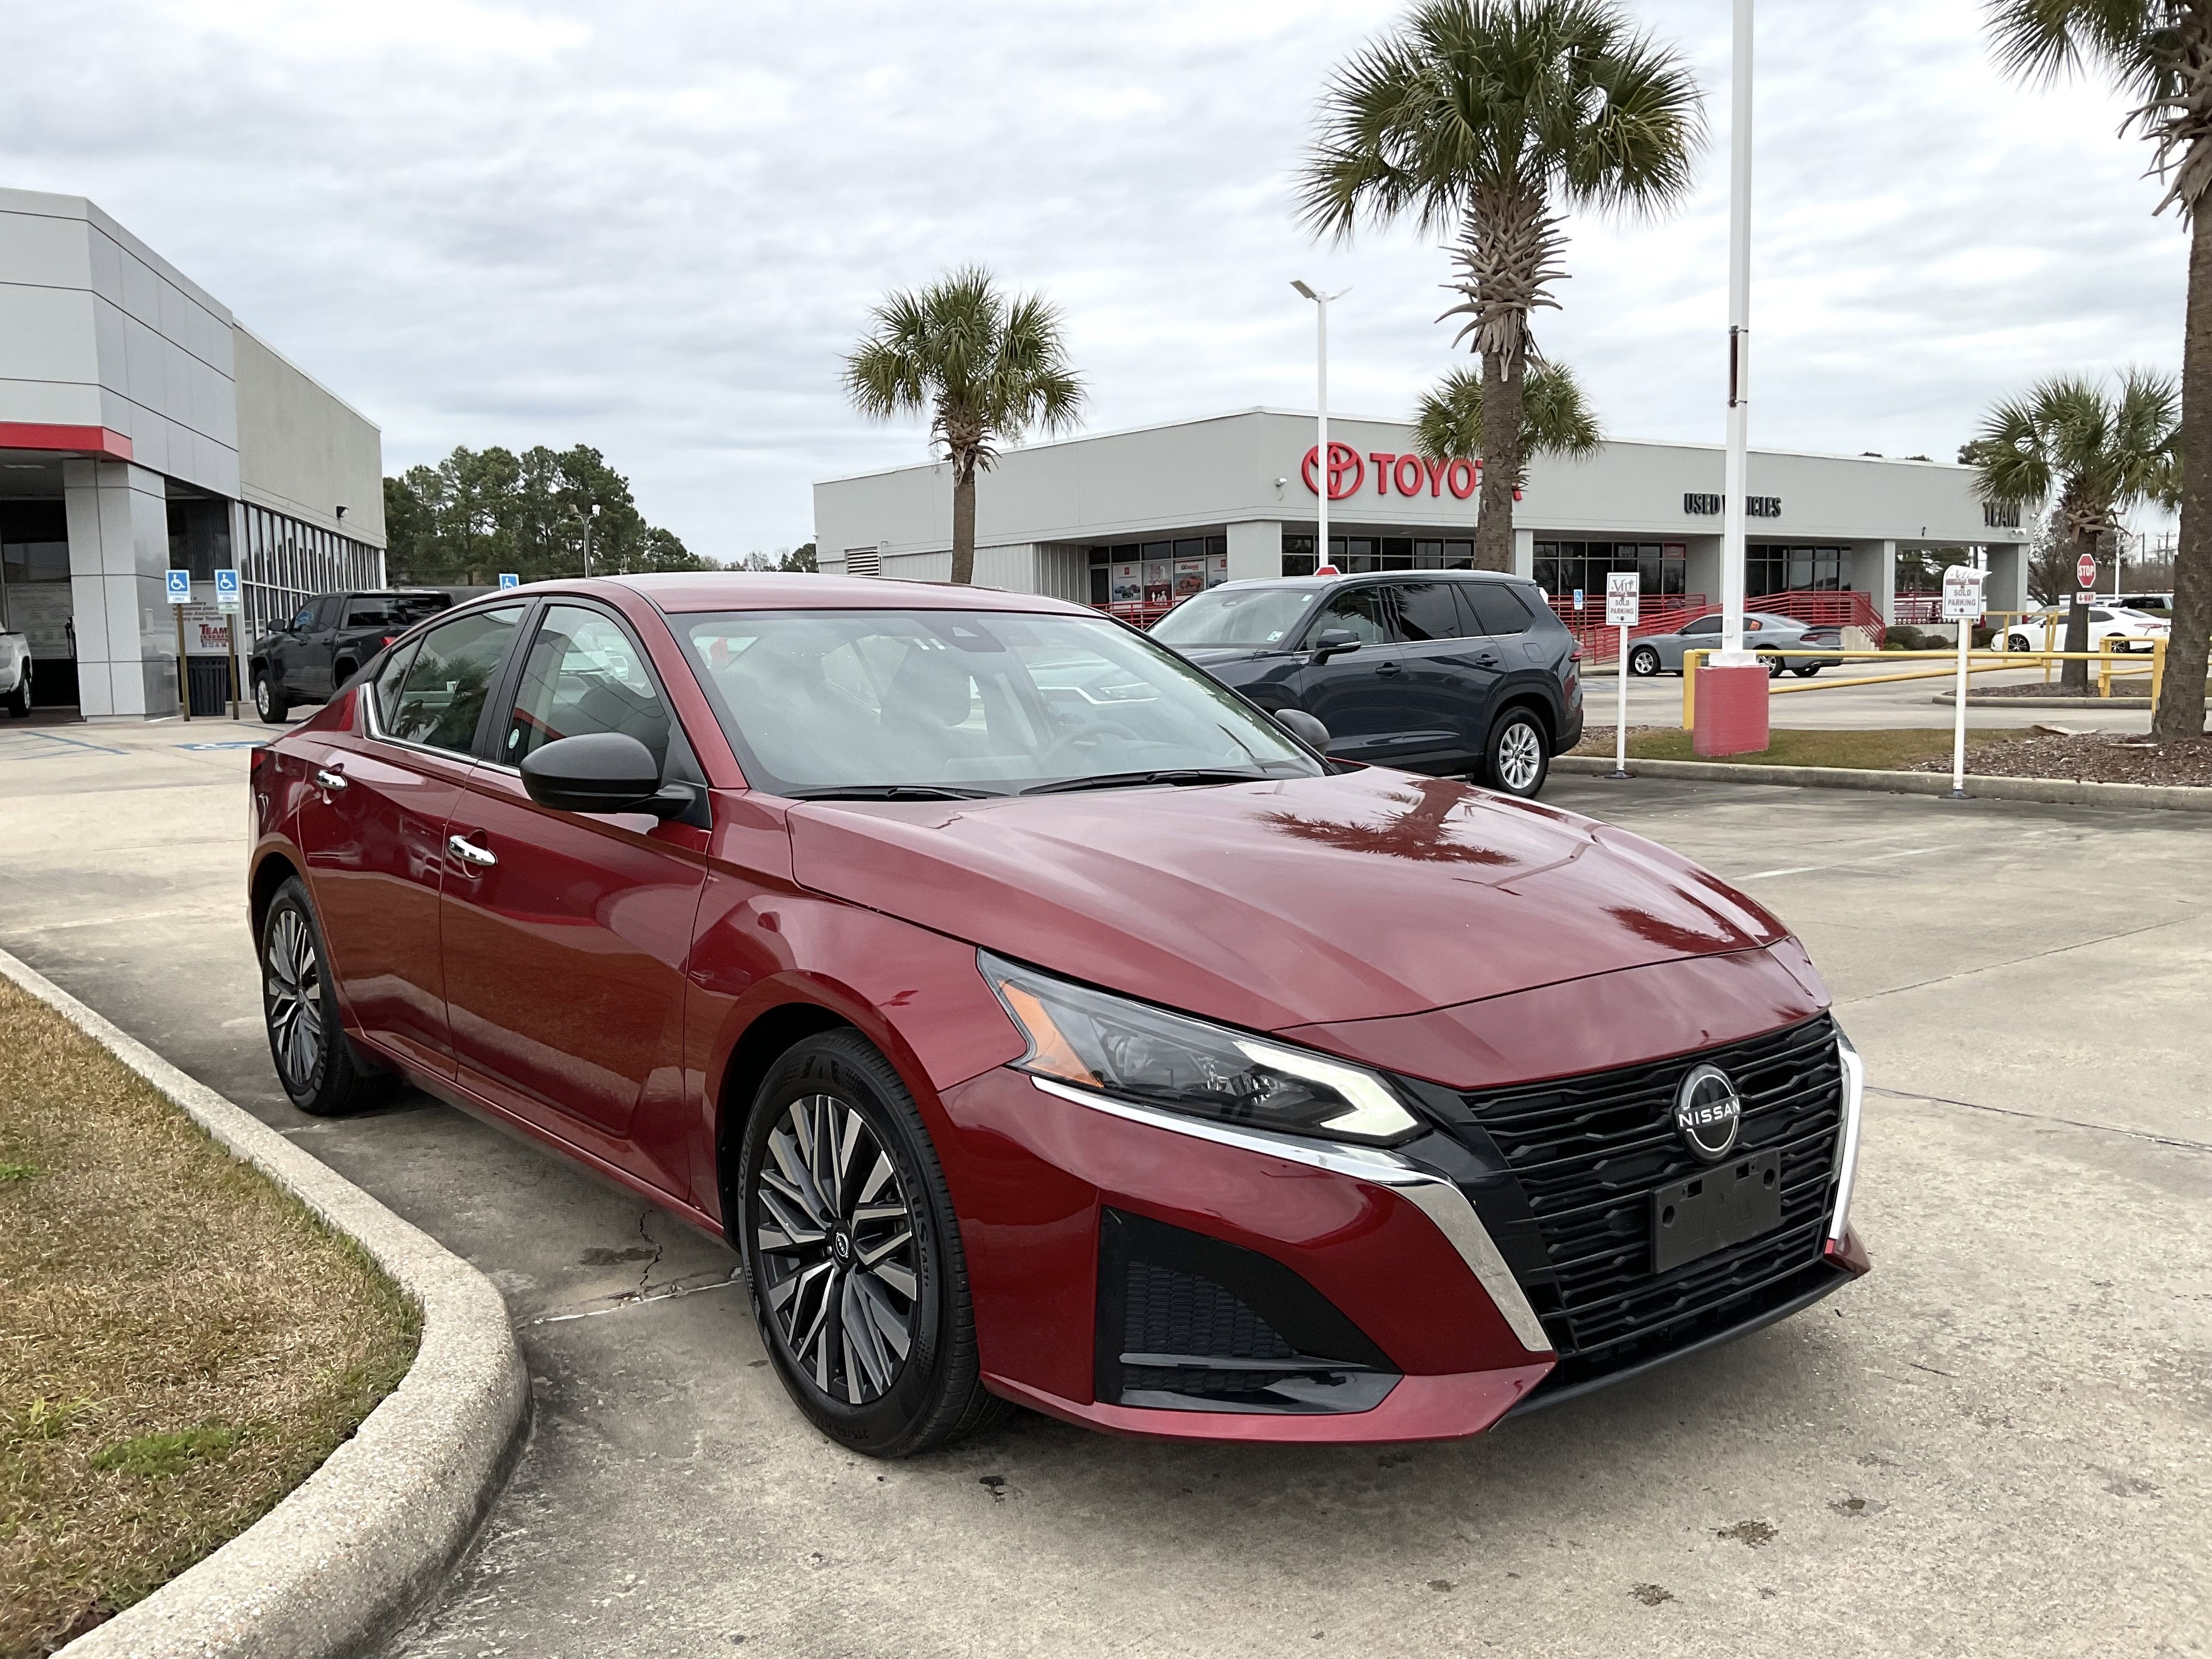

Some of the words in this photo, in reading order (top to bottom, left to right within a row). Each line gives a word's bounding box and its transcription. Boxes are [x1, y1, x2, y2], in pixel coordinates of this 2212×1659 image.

[1370, 453, 1522, 500] TOYO
[1684, 493, 1720, 514] USED
[2079, 565, 2094, 577] STOP
[199, 624, 227, 635] TEAM
[1679, 1098, 1740, 1127] NISSAN
